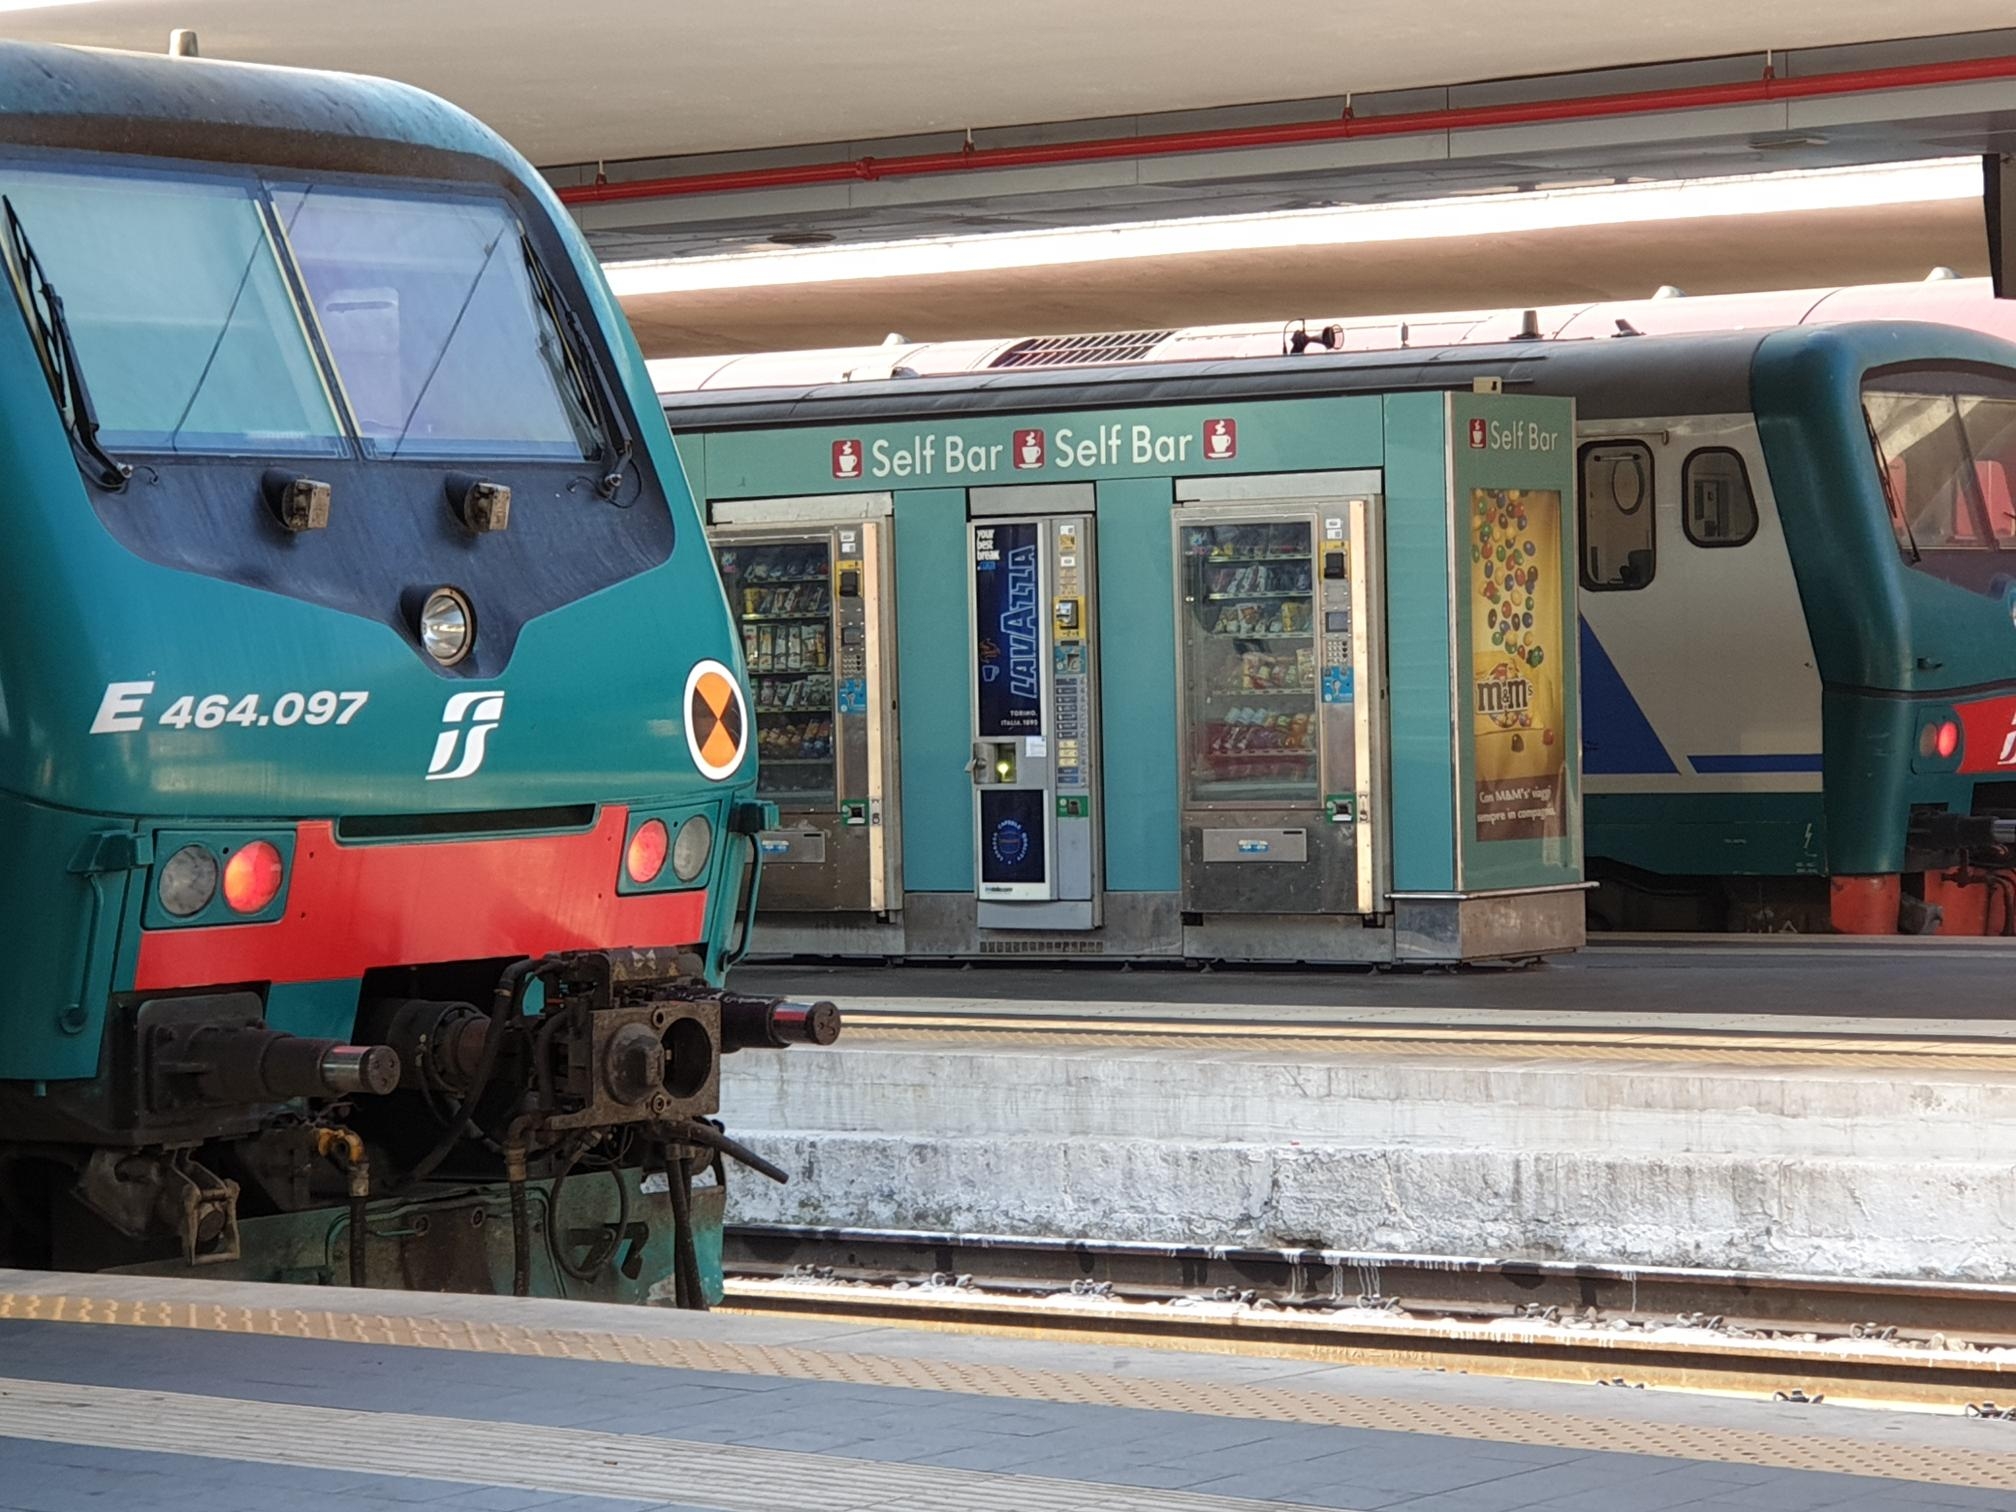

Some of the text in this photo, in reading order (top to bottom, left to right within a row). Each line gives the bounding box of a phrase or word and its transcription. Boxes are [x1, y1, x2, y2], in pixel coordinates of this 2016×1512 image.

[872, 434, 1004, 477] Self Bar
[1055, 424, 1193, 468] Self Bar
[1491, 420, 1558, 451] Self Bar
[1001, 545, 1037, 698] LAVAZZA
[89, 681, 369, 735] E 464.097
